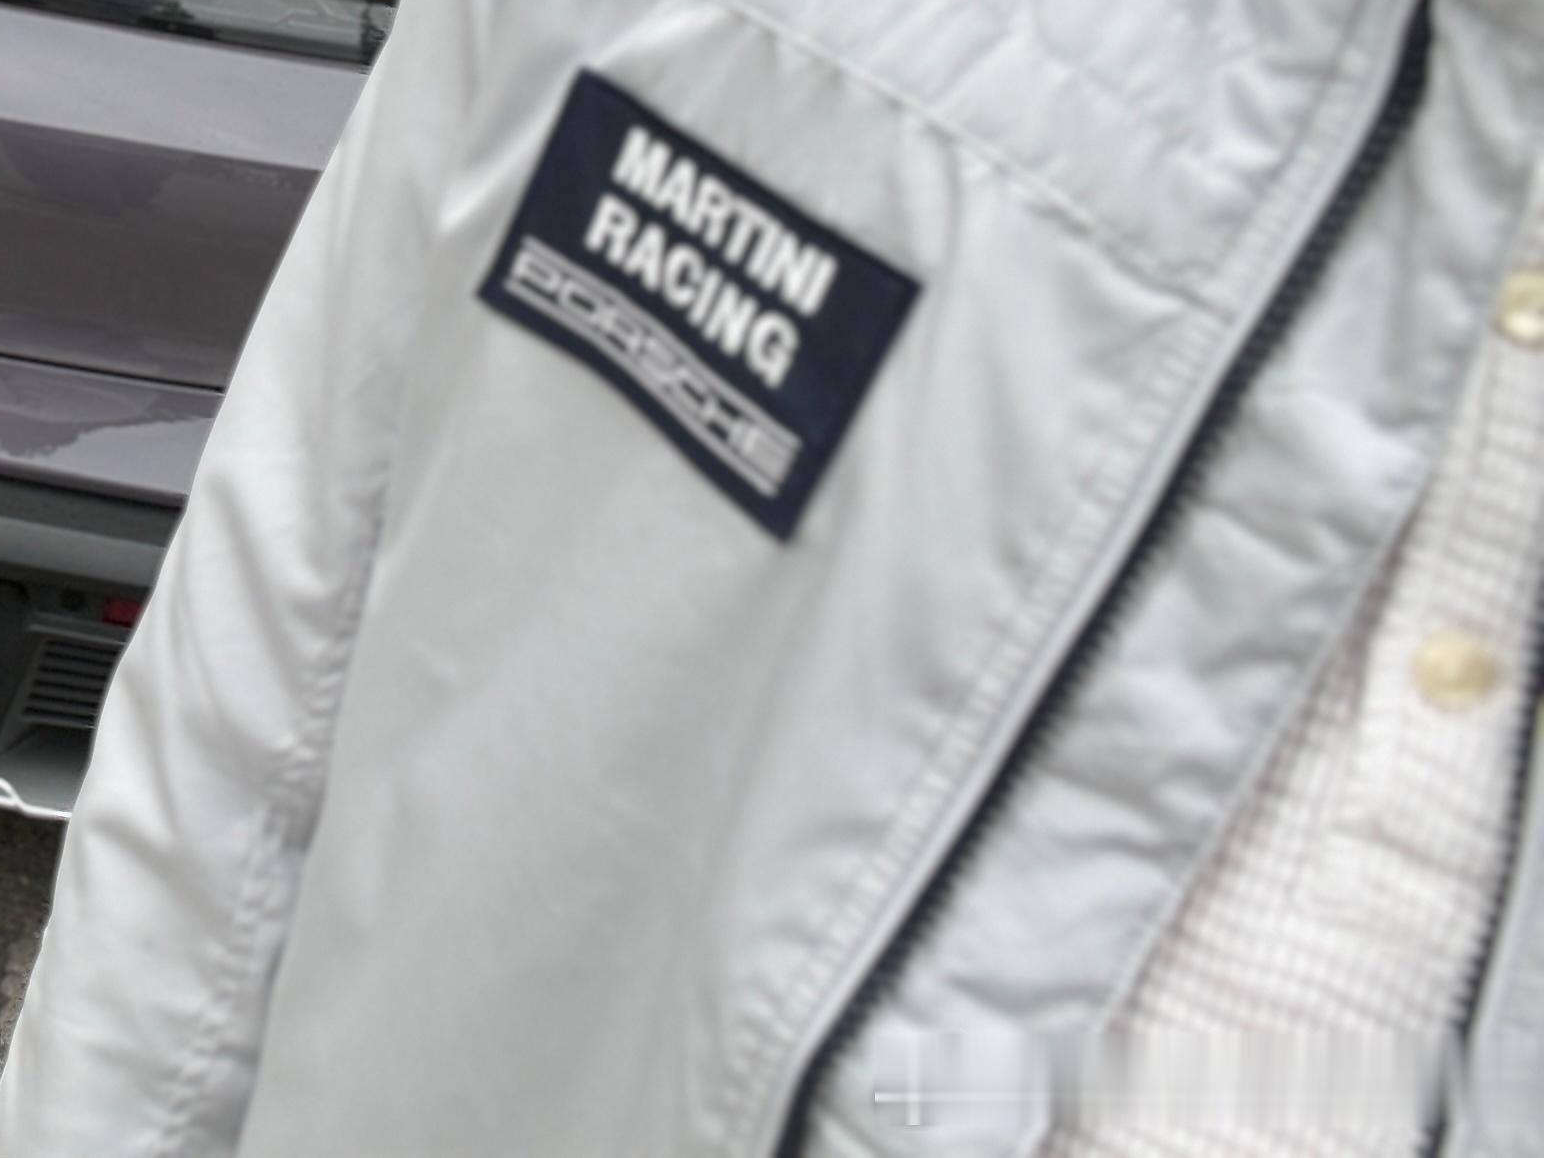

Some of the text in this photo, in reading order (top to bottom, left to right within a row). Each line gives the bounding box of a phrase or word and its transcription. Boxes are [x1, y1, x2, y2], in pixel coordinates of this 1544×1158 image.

[584, 193, 799, 389] RACING
[611, 126, 838, 317] MARTINI
[507, 244, 798, 488] PORSCHE
